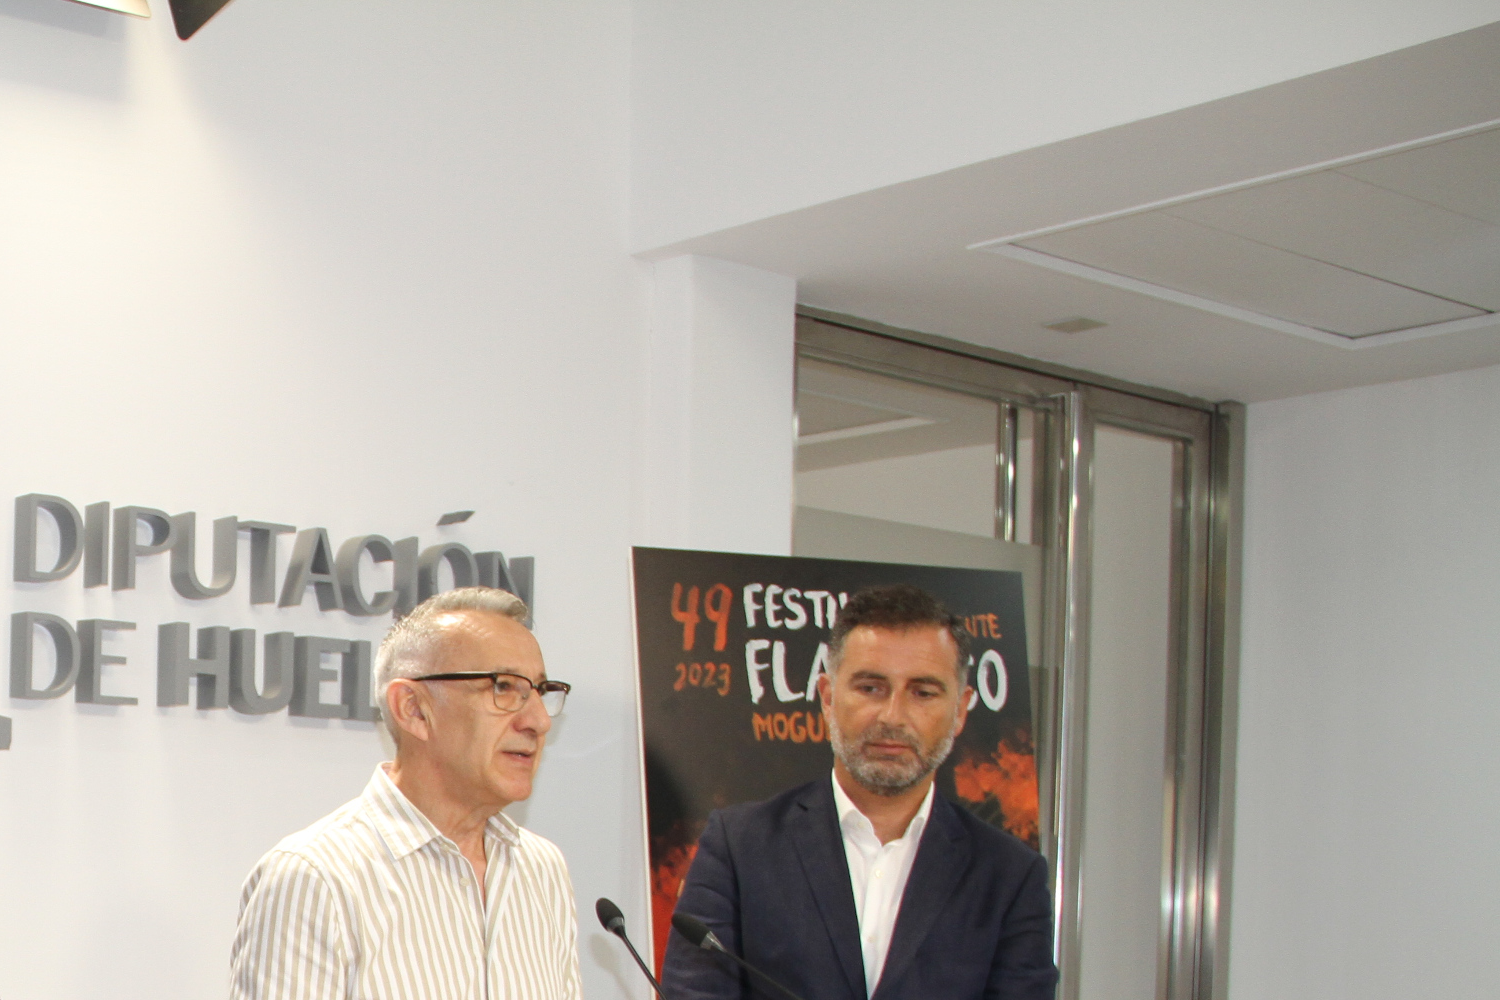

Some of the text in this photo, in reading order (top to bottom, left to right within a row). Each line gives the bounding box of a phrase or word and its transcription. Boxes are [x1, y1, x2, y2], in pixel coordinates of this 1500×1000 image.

[13, 492, 534, 632] DIPUTACIÓN
[671, 582, 733, 652] 49
[743, 583, 848, 630] FESTI
[11, 611, 384, 723] DE HUEL
[673, 662, 731, 696] 2023
[752, 711, 831, 743] MOGU
